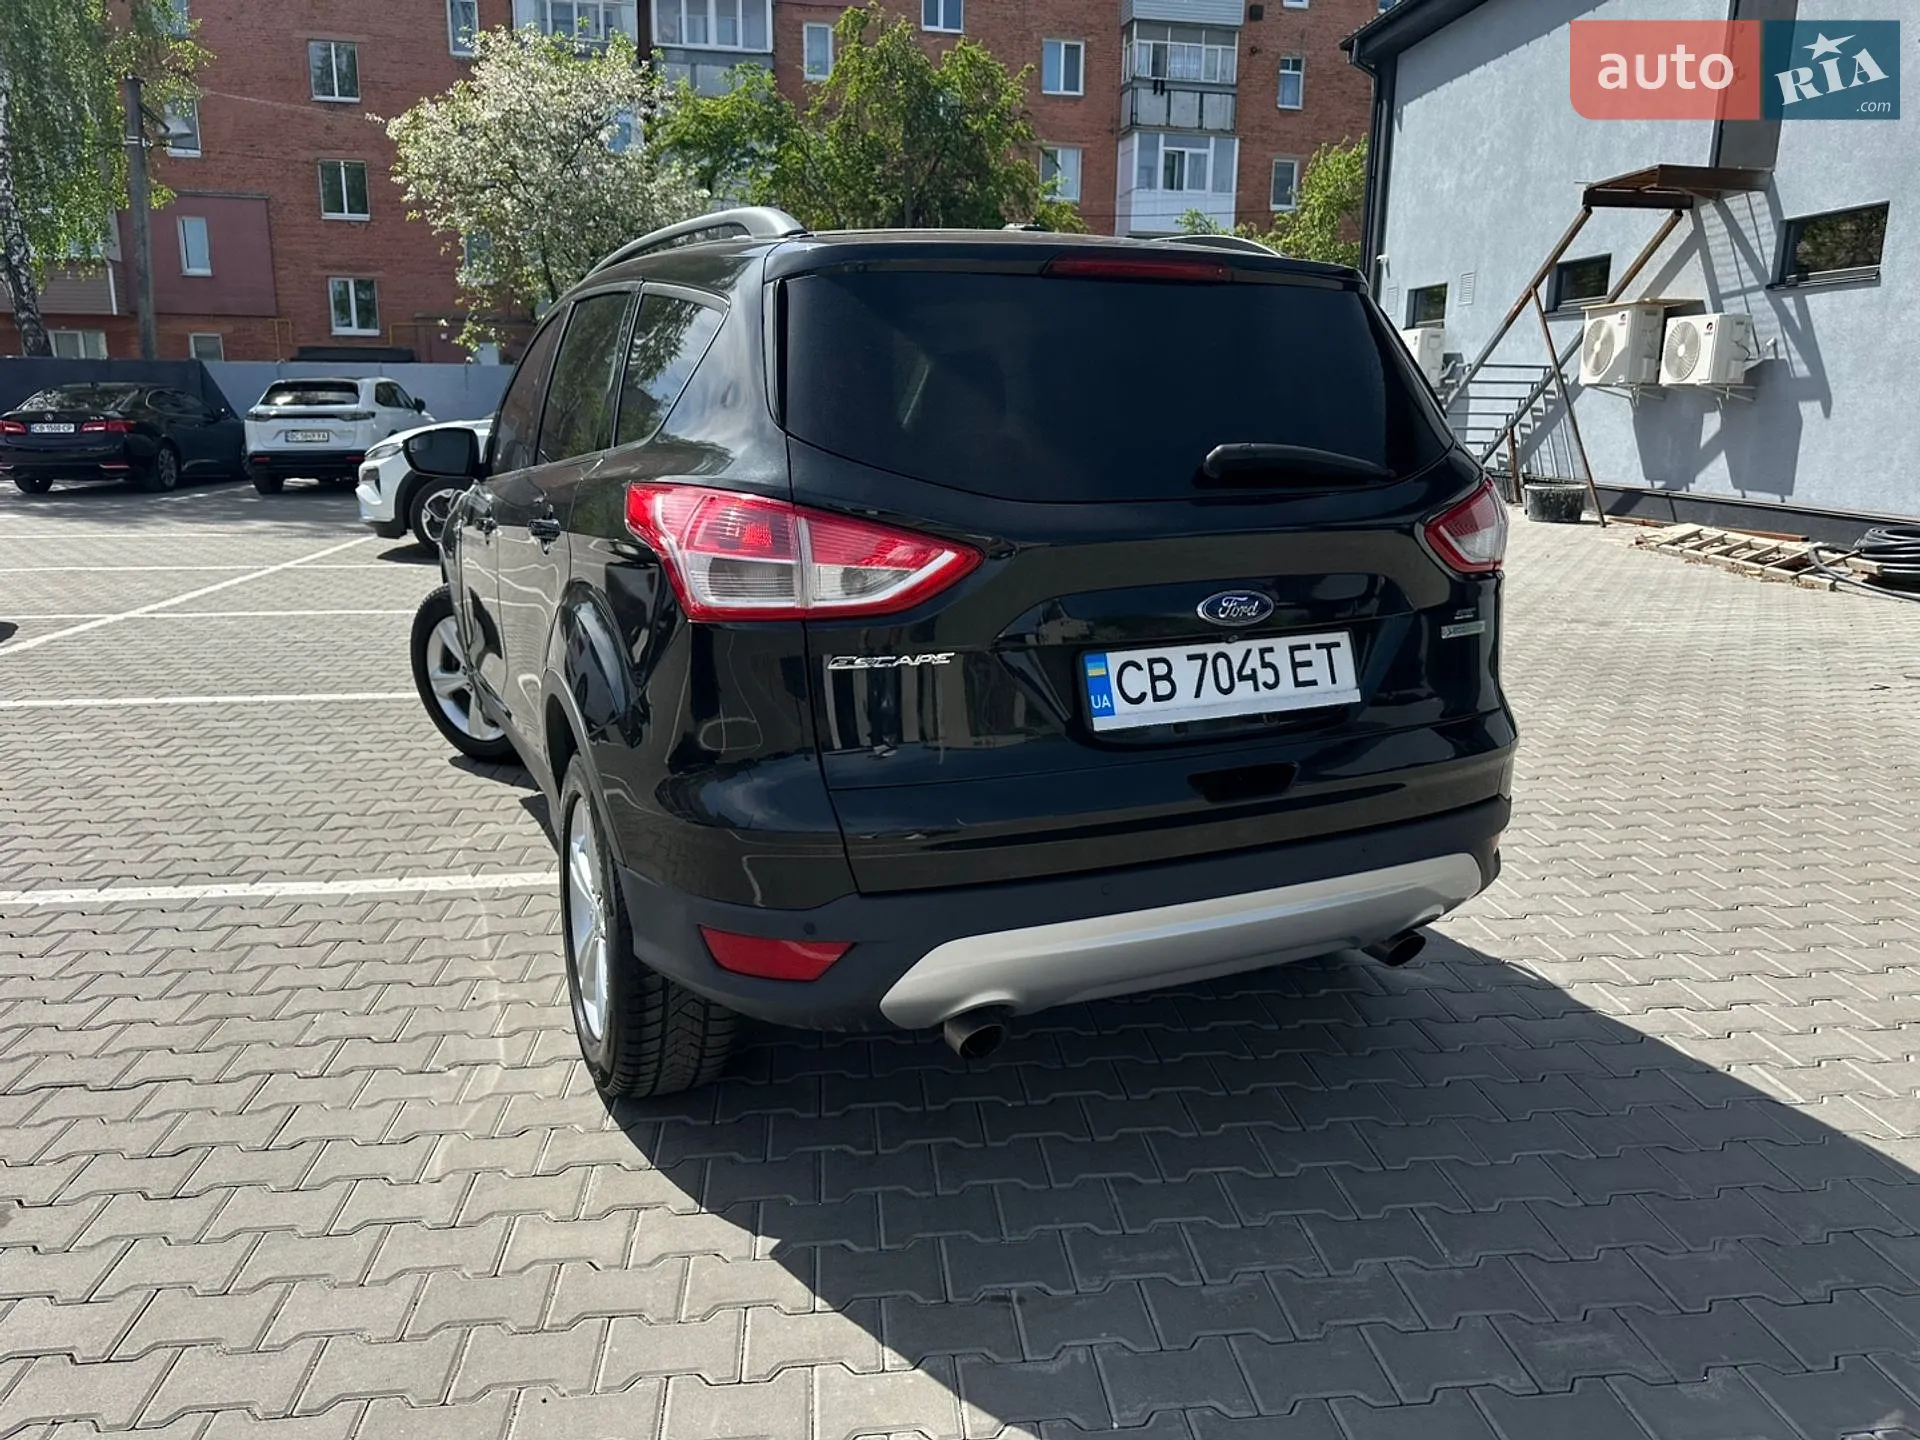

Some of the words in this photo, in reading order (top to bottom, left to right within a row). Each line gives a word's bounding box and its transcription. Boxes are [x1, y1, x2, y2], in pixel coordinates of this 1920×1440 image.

[1217, 596, 1260, 619] Ford
[827, 652, 955, 670] ESCAPE
[1116, 657, 1178, 705] CB
[1186, 647, 1280, 699] 7045
[1292, 642, 1343, 688] ET
[1091, 695, 1112, 711] UA
